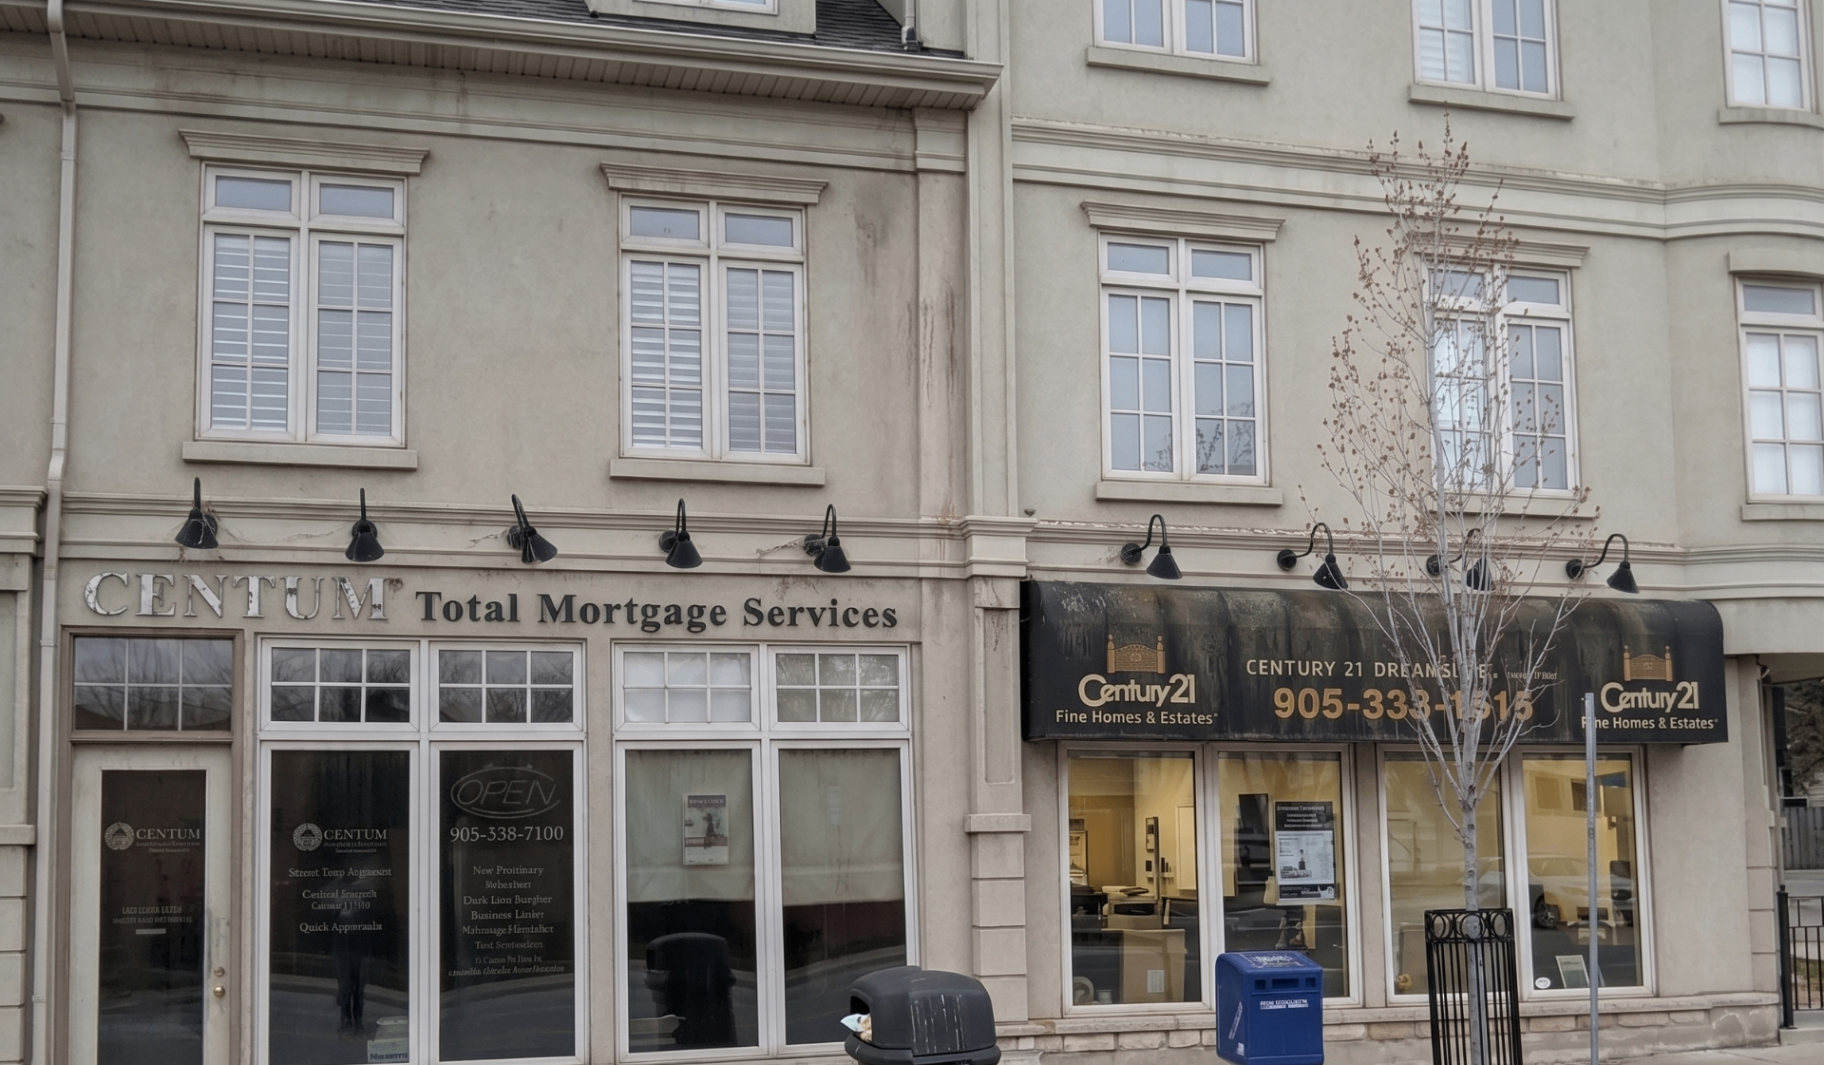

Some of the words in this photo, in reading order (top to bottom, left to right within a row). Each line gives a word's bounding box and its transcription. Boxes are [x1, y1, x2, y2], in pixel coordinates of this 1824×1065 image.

[84, 572, 388, 620] CENTUM
[415, 591, 519, 622] Total
[536, 593, 727, 633] Mortgage
[743, 596, 897, 628] Services
[1246, 659, 1336, 677] CENTURY
[1344, 661, 1362, 677] 21
[1056, 709, 1087, 723] Fine
[1092, 710, 1142, 724] Homes
[1146, 711, 1156, 724] &
[1581, 716, 1609, 729] Fne
[1613, 716, 1655, 729] Homes
[1659, 717, 1667, 729] &
[457, 779, 557, 805] OPEN
[136, 828, 200, 839] CENTUM
[323, 829, 387, 840] CENTUM
[450, 825, 564, 842] 905-338-7100
[299, 922, 329, 933] Quick
